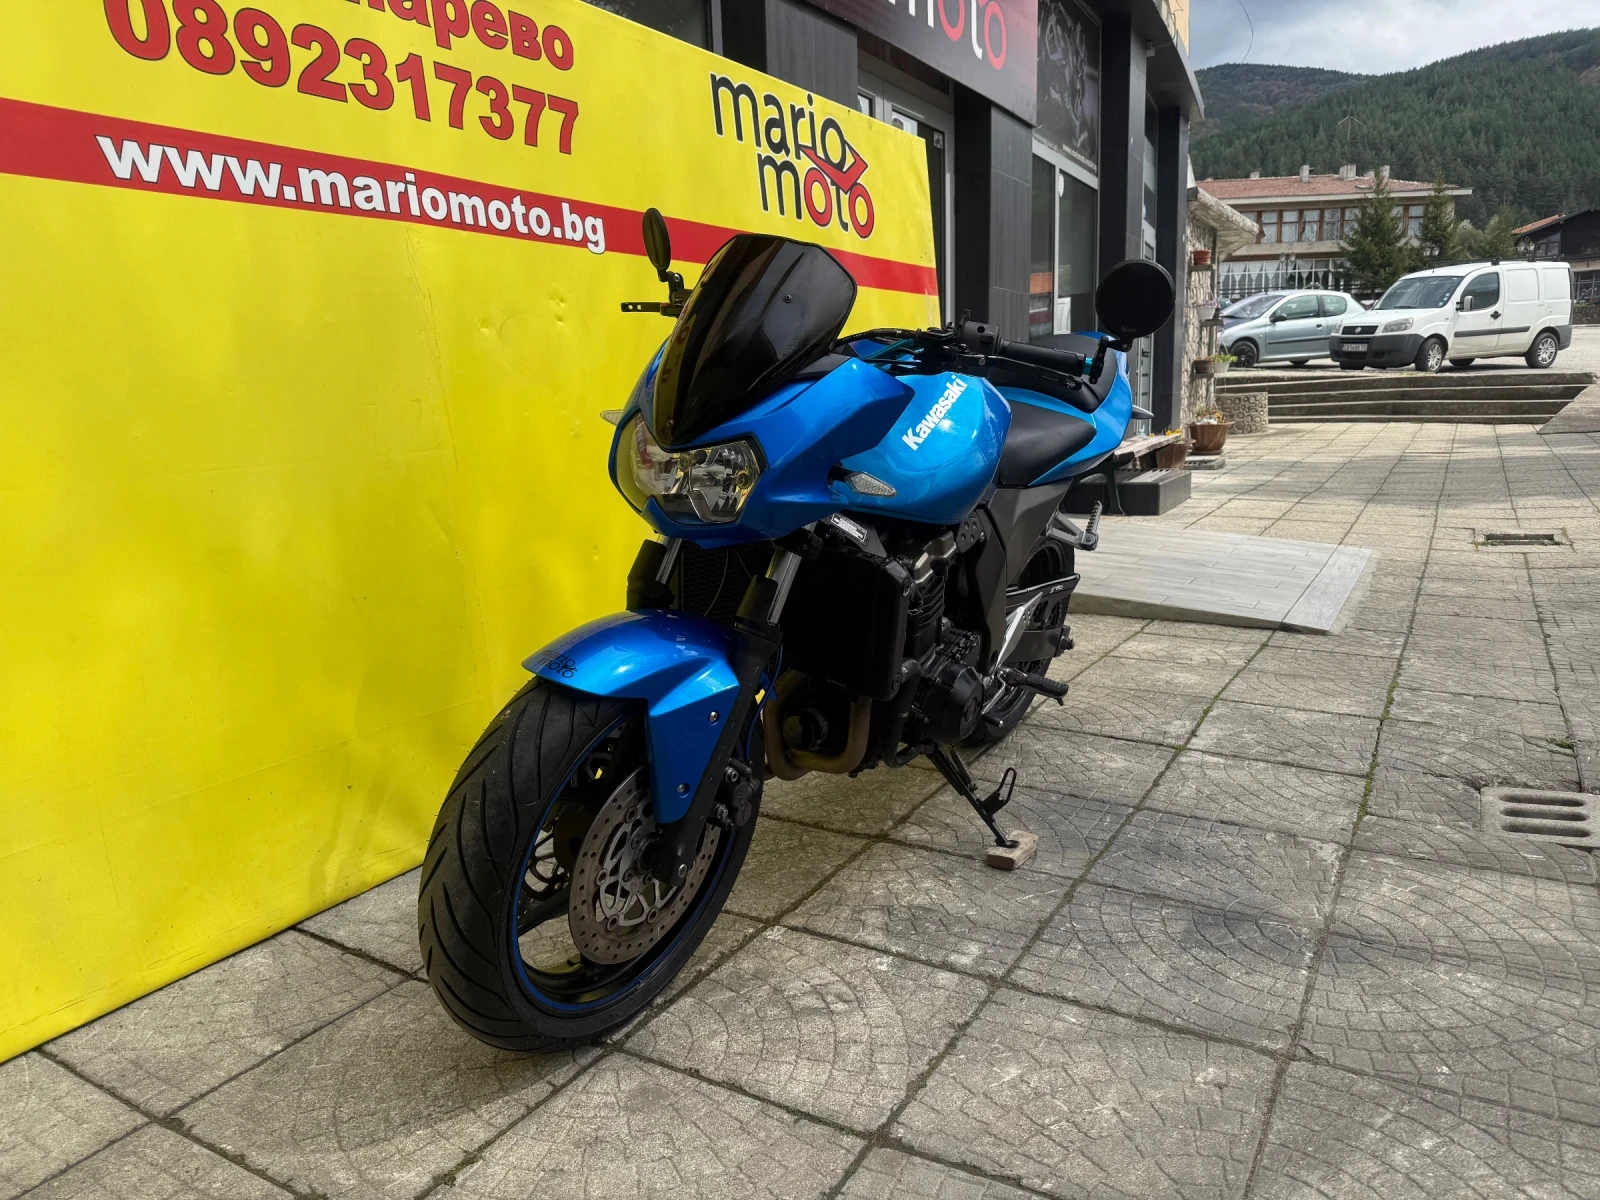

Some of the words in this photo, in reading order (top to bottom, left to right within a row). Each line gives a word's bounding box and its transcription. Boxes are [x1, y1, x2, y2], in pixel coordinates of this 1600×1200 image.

[104, 0, 579, 155] 0892317377
[710, 73, 847, 172] mario
[94, 134, 606, 255] www.mariomoto.bg
[757, 152, 875, 239] moto
[901, 374, 968, 451] Kawasaki
